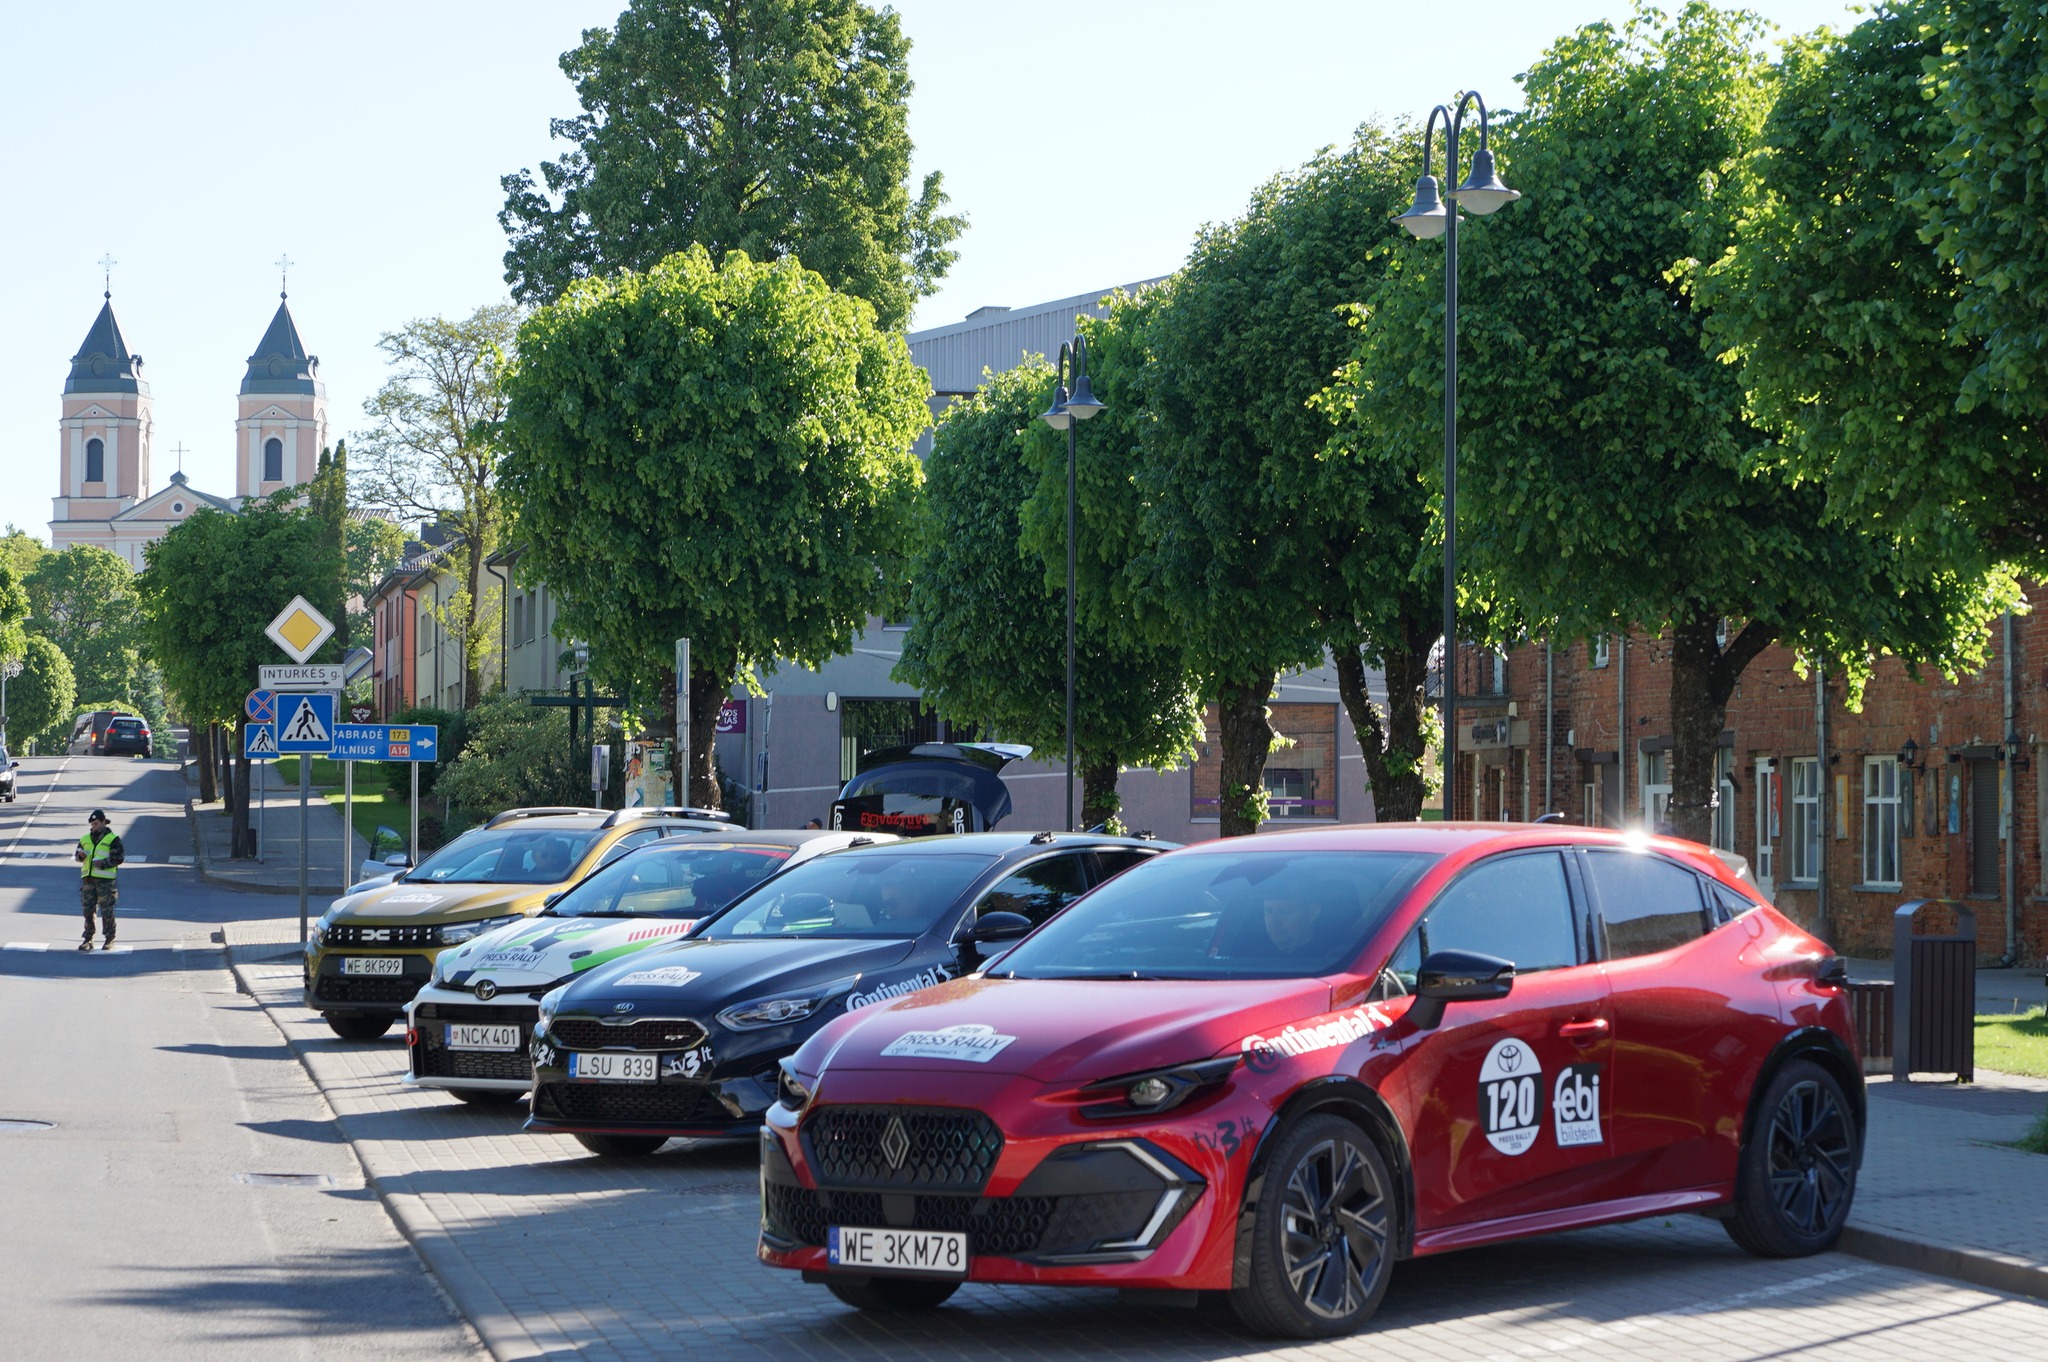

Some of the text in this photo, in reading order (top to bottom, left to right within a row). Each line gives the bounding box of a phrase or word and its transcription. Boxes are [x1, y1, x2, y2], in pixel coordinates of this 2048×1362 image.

[263, 667, 341, 681] INTURKĖS g.
[333, 728, 408, 740] PABRADĖ 173
[333, 745, 409, 755] VILNIUS A14
[480, 952, 541, 963] PRESS RALLY
[346, 959, 400, 973] WE 8KR99
[615, 1003, 631, 1011] KIA
[460, 1027, 516, 1046] NCK 401
[896, 1034, 1006, 1050] PRESS RALLY
[1241, 1005, 1375, 1075] Continental
[578, 1056, 612, 1076] LSU
[622, 1058, 654, 1078] 839
[1552, 1066, 1600, 1122] febi
[1487, 1076, 1536, 1132] 120
[1498, 1132, 1531, 1144] PRESS RALLY
[1561, 1124, 1598, 1142] bilstein
[830, 1231, 960, 1267] PL WE 3KM78
